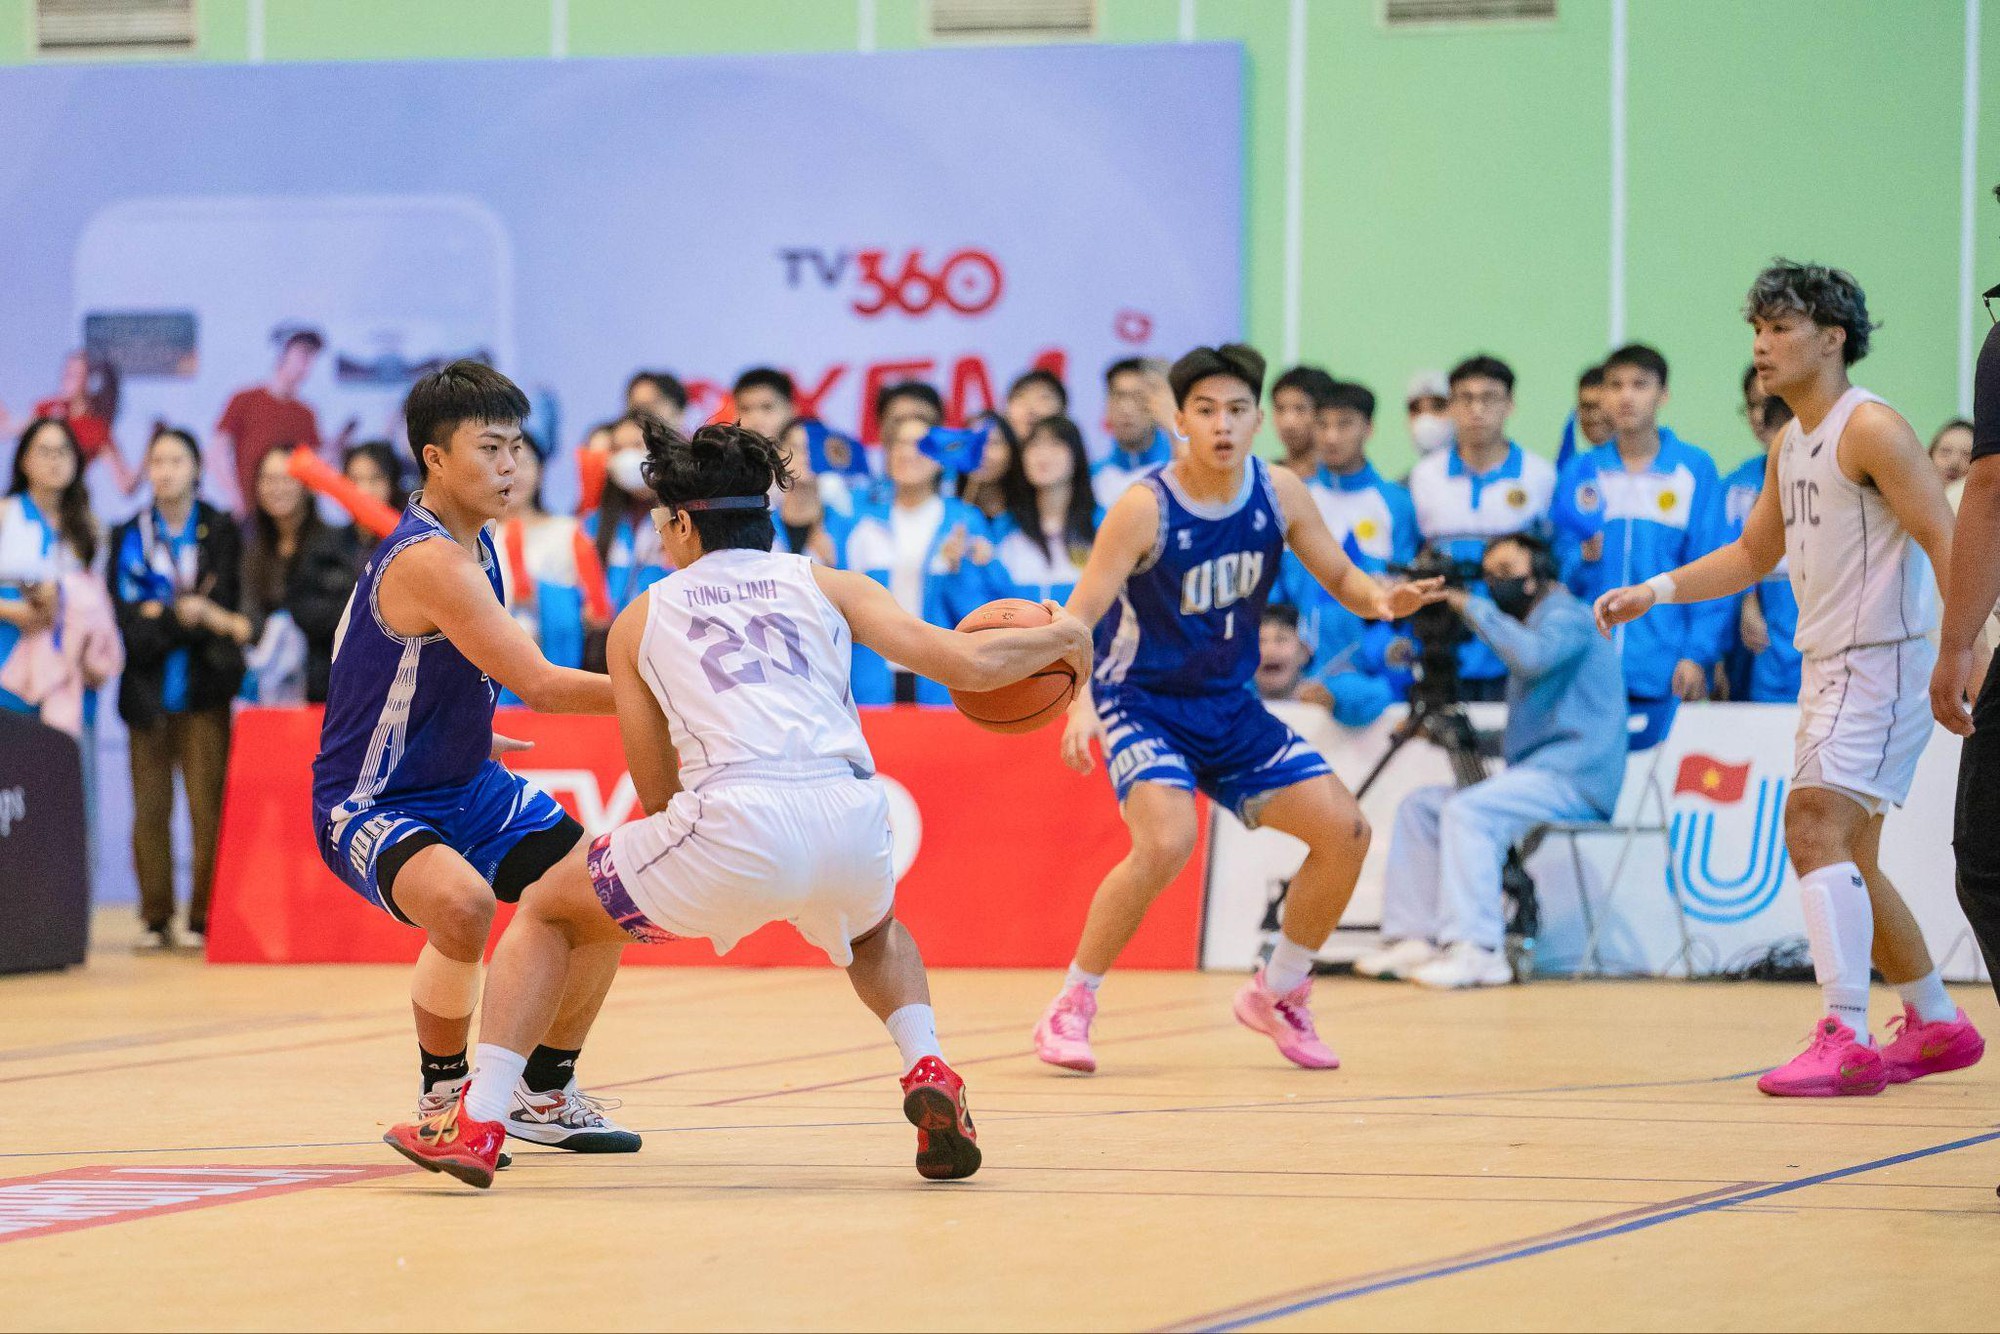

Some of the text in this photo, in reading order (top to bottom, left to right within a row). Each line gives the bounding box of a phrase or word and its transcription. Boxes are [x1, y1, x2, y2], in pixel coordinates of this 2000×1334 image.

[778, 247, 1004, 316] TV360
[736, 579, 778, 601] LINH
[1223, 611, 1235, 640] 1
[686, 612, 812, 694] 20
